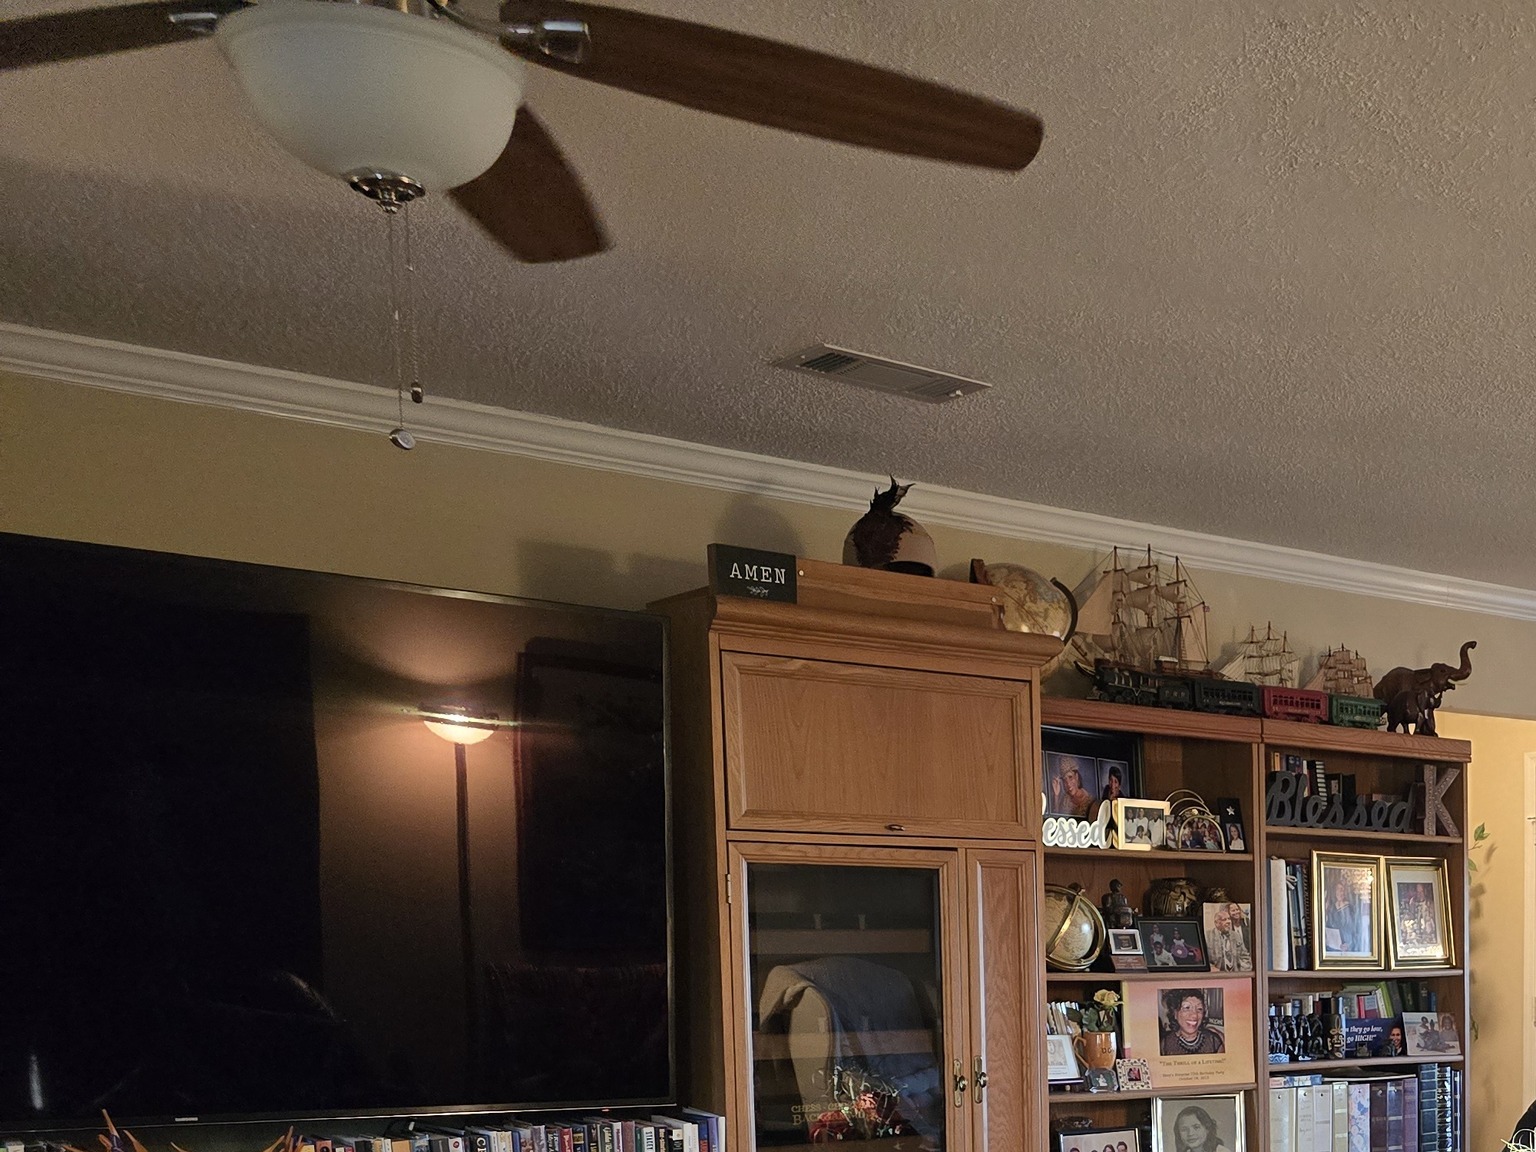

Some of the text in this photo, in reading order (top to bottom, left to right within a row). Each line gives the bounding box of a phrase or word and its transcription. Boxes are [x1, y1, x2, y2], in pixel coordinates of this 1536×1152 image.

[729, 562, 786, 585] AMEN
[1266, 771, 1416, 833] Blessed
[1423, 764, 1461, 838] K
[1346, 1036, 1354, 1044] go
[1350, 1025, 1363, 1034] they
[645, 1131, 653, 1150] STACEY
